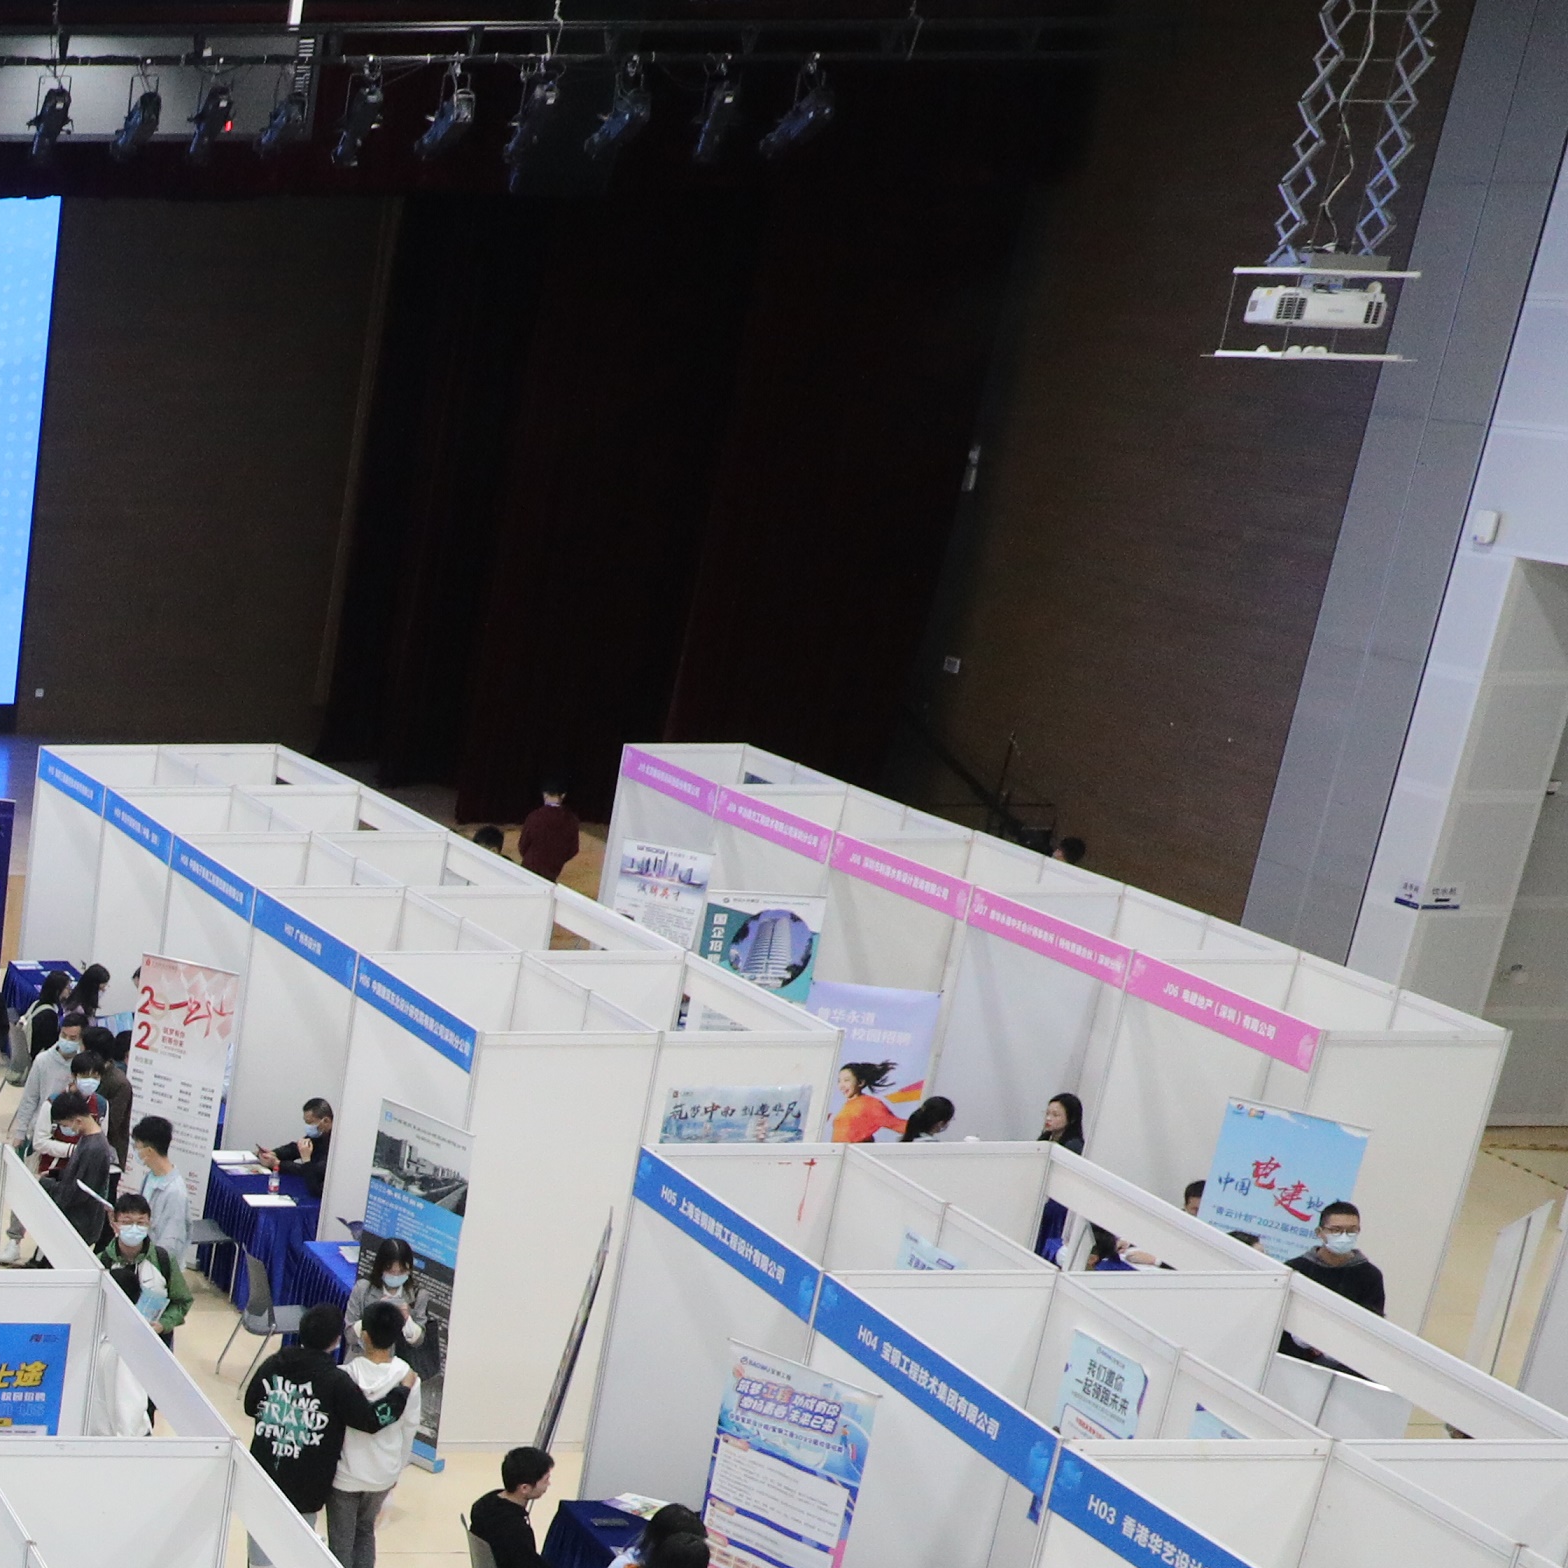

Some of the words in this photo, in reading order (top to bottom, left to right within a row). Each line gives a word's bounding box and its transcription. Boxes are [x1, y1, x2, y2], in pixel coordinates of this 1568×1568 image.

[1164, 980, 1181, 998] J06
[659, 1184, 679, 1208] H05
[1218, 1156, 1341, 1223] 中国电建地
[856, 1322, 877, 1350] H04
[879, 1339, 1001, 1441] 宝钢工程技术集团有限公司
[1086, 1357, 1125, 1393] 我们邀你
[1074, 1376, 1131, 1417] 一起领跑未来
[271, 1441, 302, 1459] TIDE
[1086, 1494, 1119, 1528] H03
